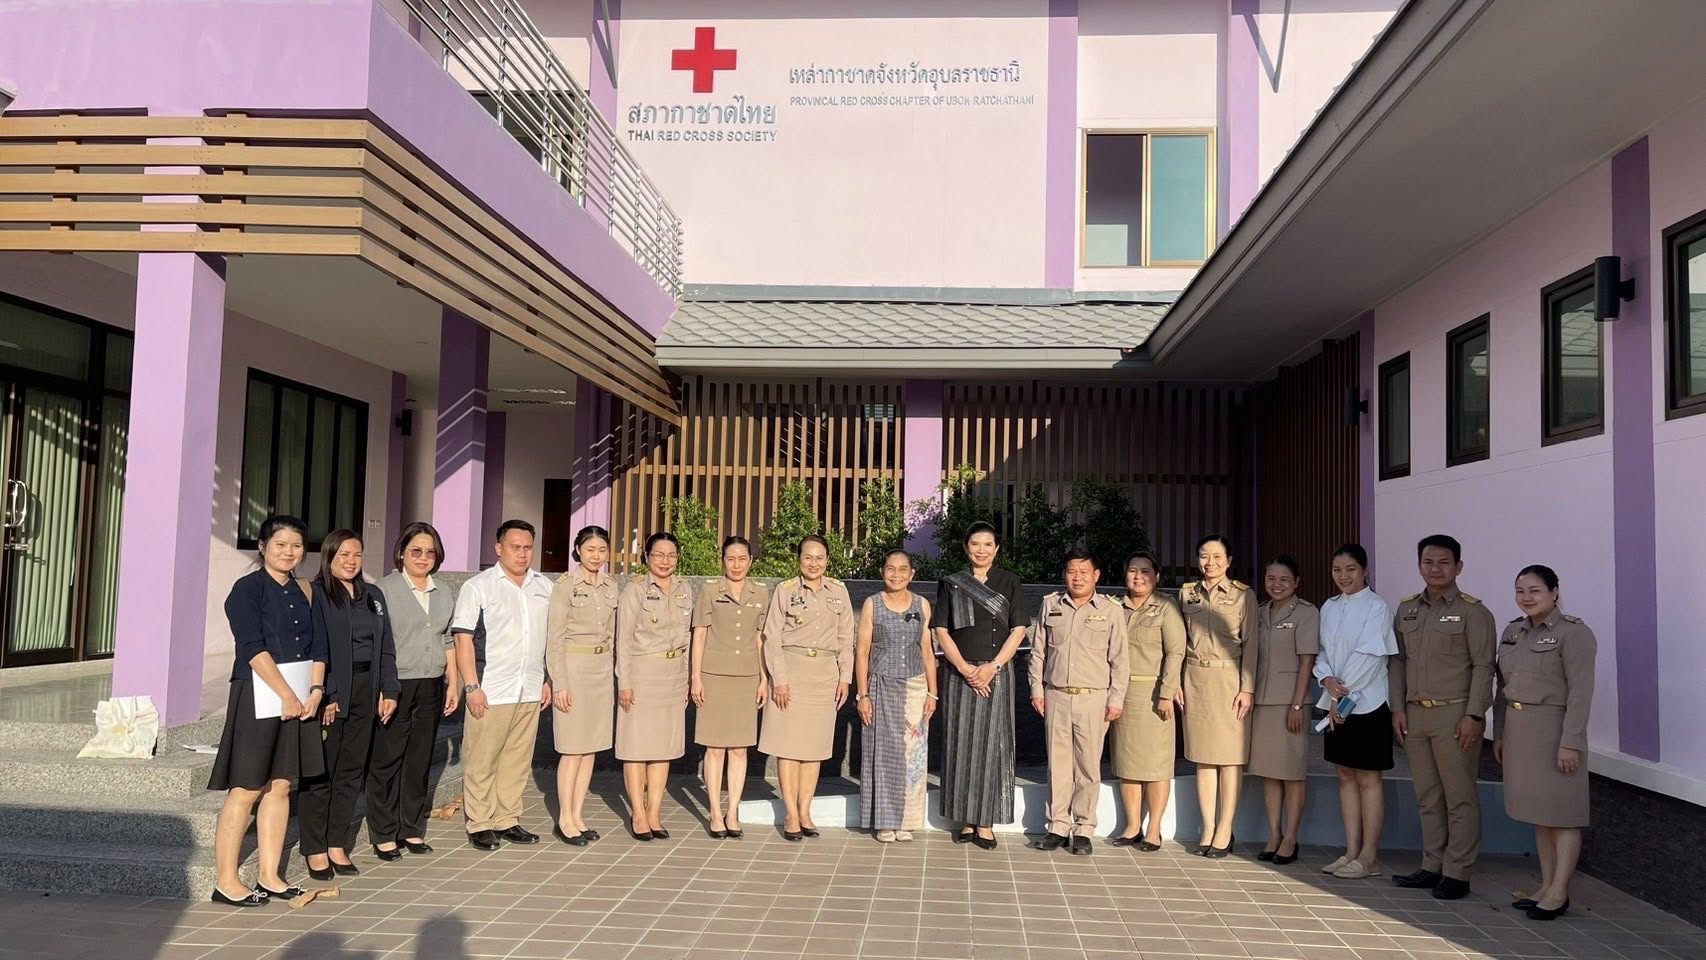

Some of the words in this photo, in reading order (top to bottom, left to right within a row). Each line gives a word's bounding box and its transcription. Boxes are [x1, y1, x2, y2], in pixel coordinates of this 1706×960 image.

[840, 95, 858, 106] RED
[860, 95, 888, 106] CROSS
[890, 95, 930, 106] CHAPTER
[932, 95, 944, 106] OF
[946, 95, 970, 106] UBON
[973, 95, 1034, 105] RATCHATHANI
[628, 95, 776, 124] สภากาชาดไทย
[628, 130, 654, 142] THAI
[657, 130, 681, 142] RED
[683, 130, 724, 142] CROSS
[727, 130, 777, 142] SOCIETY
